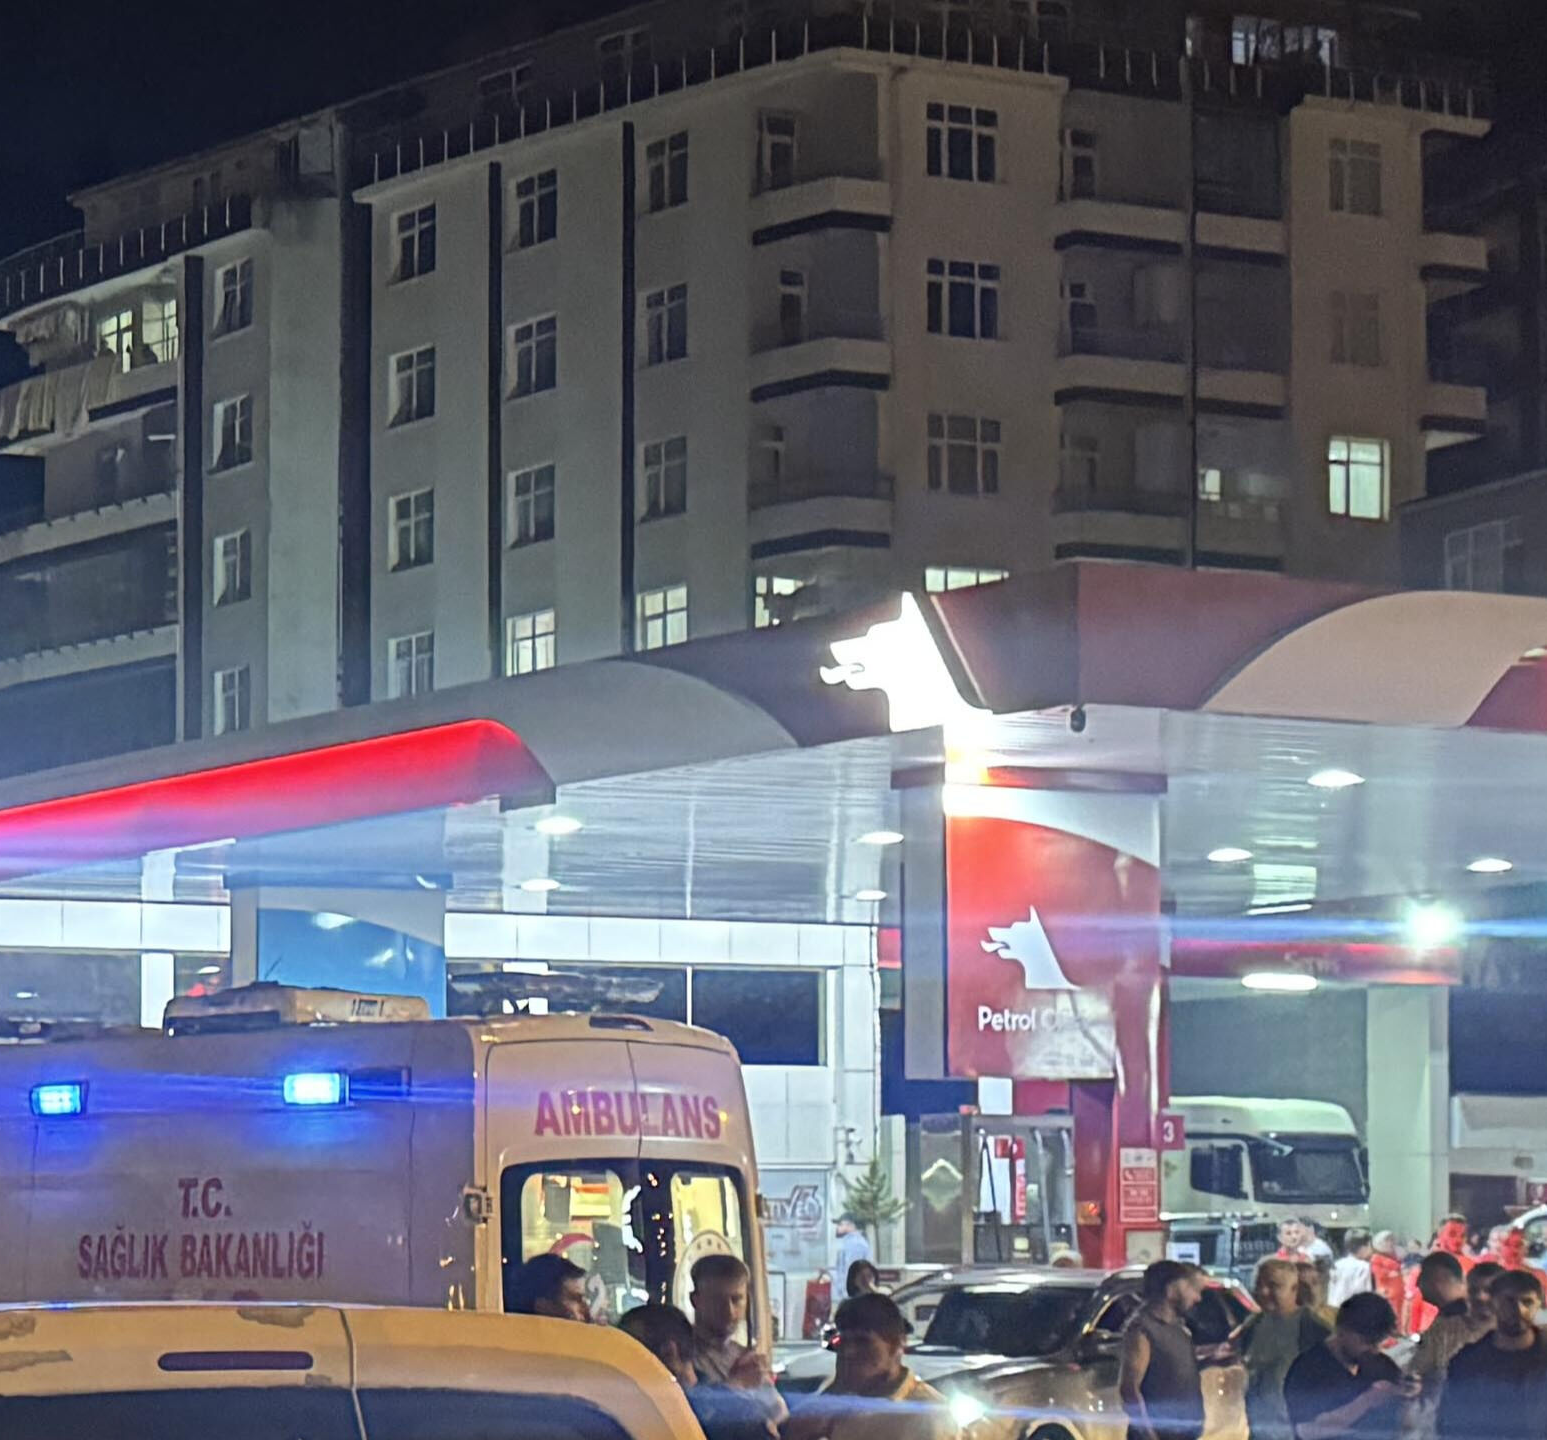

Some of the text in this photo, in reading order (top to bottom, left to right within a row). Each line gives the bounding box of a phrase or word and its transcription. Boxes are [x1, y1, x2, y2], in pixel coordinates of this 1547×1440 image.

[978, 1005, 1036, 1031] Petrol
[534, 1091, 722, 1139] AMBULANS
[1163, 1120, 1175, 1143] 3
[178, 1178, 232, 1218] T.C.
[78, 1220, 325, 1280] SAĞLIK BAKANLIĞI
